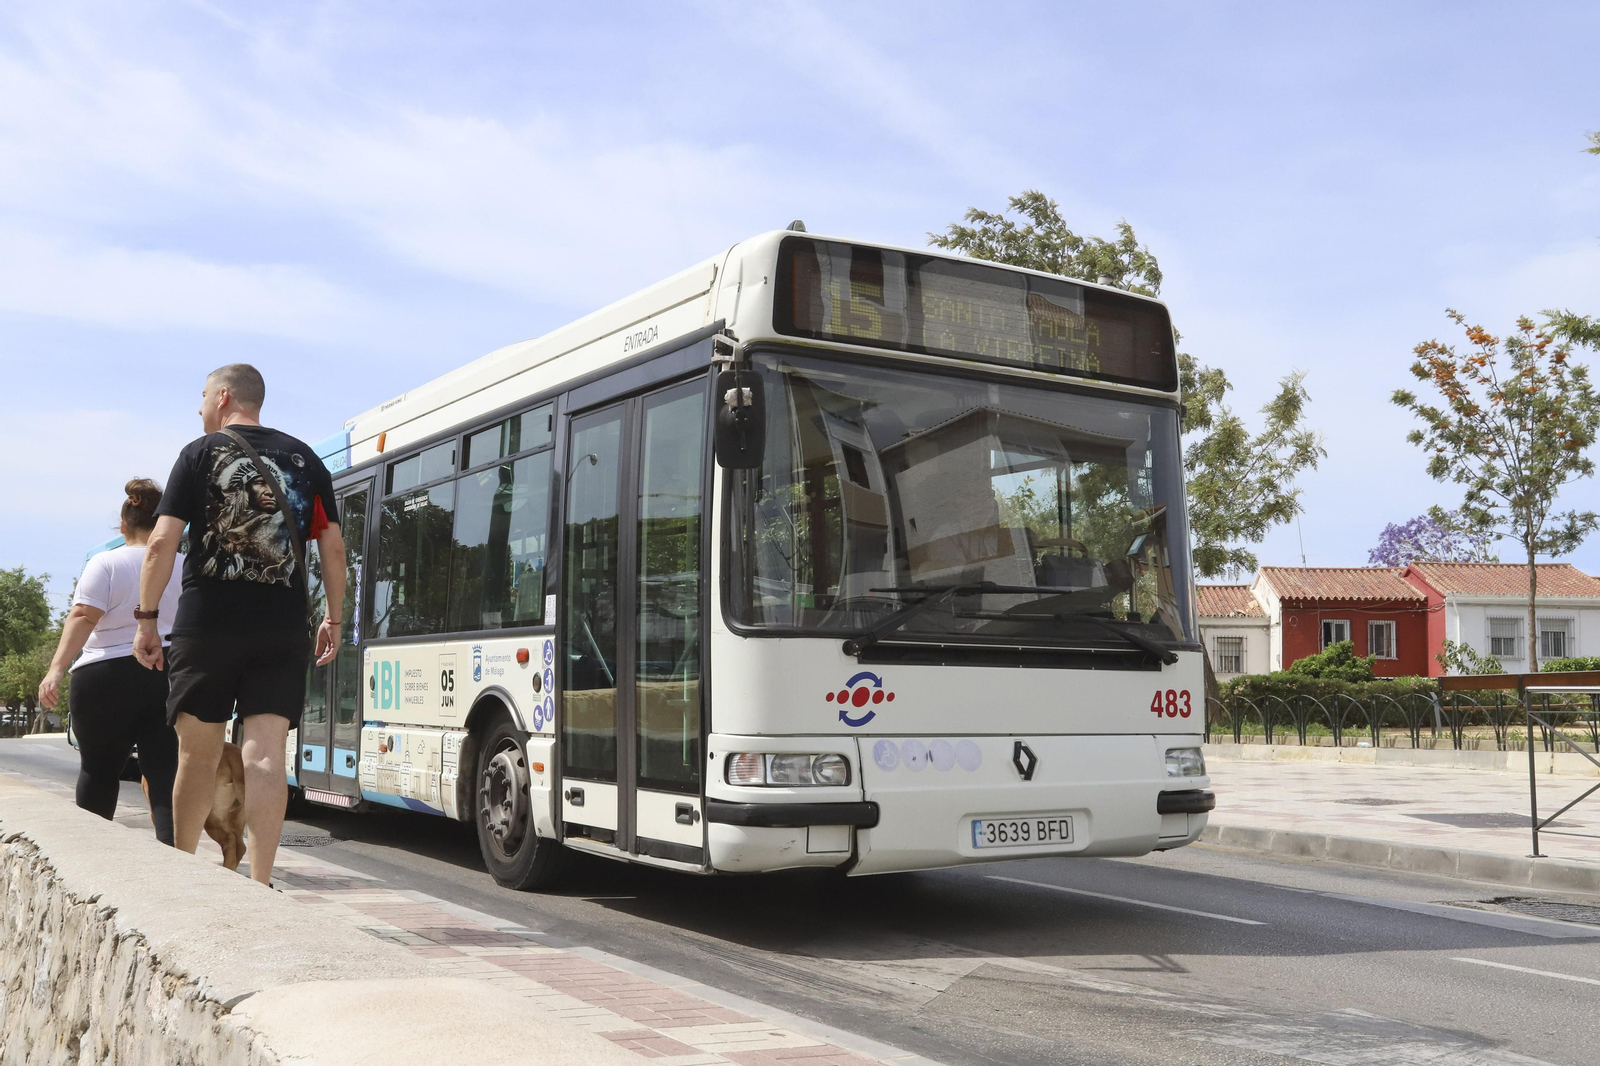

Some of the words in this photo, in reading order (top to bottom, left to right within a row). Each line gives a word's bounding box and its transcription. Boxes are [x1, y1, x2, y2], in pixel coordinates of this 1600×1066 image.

[825, 279, 882, 339] 15
[623, 325, 659, 352] ENTRADA
[485, 653, 511, 664] Ayuntamiento
[404, 669, 422, 678] IMPUESTO
[441, 669, 455, 692] 05
[485, 667, 491, 676] de
[373, 660, 401, 710] IBI
[441, 695, 454, 707] JUN
[1150, 689, 1192, 718] 483
[986, 821, 1031, 843] 3639
[1037, 820, 1069, 841] BFD
